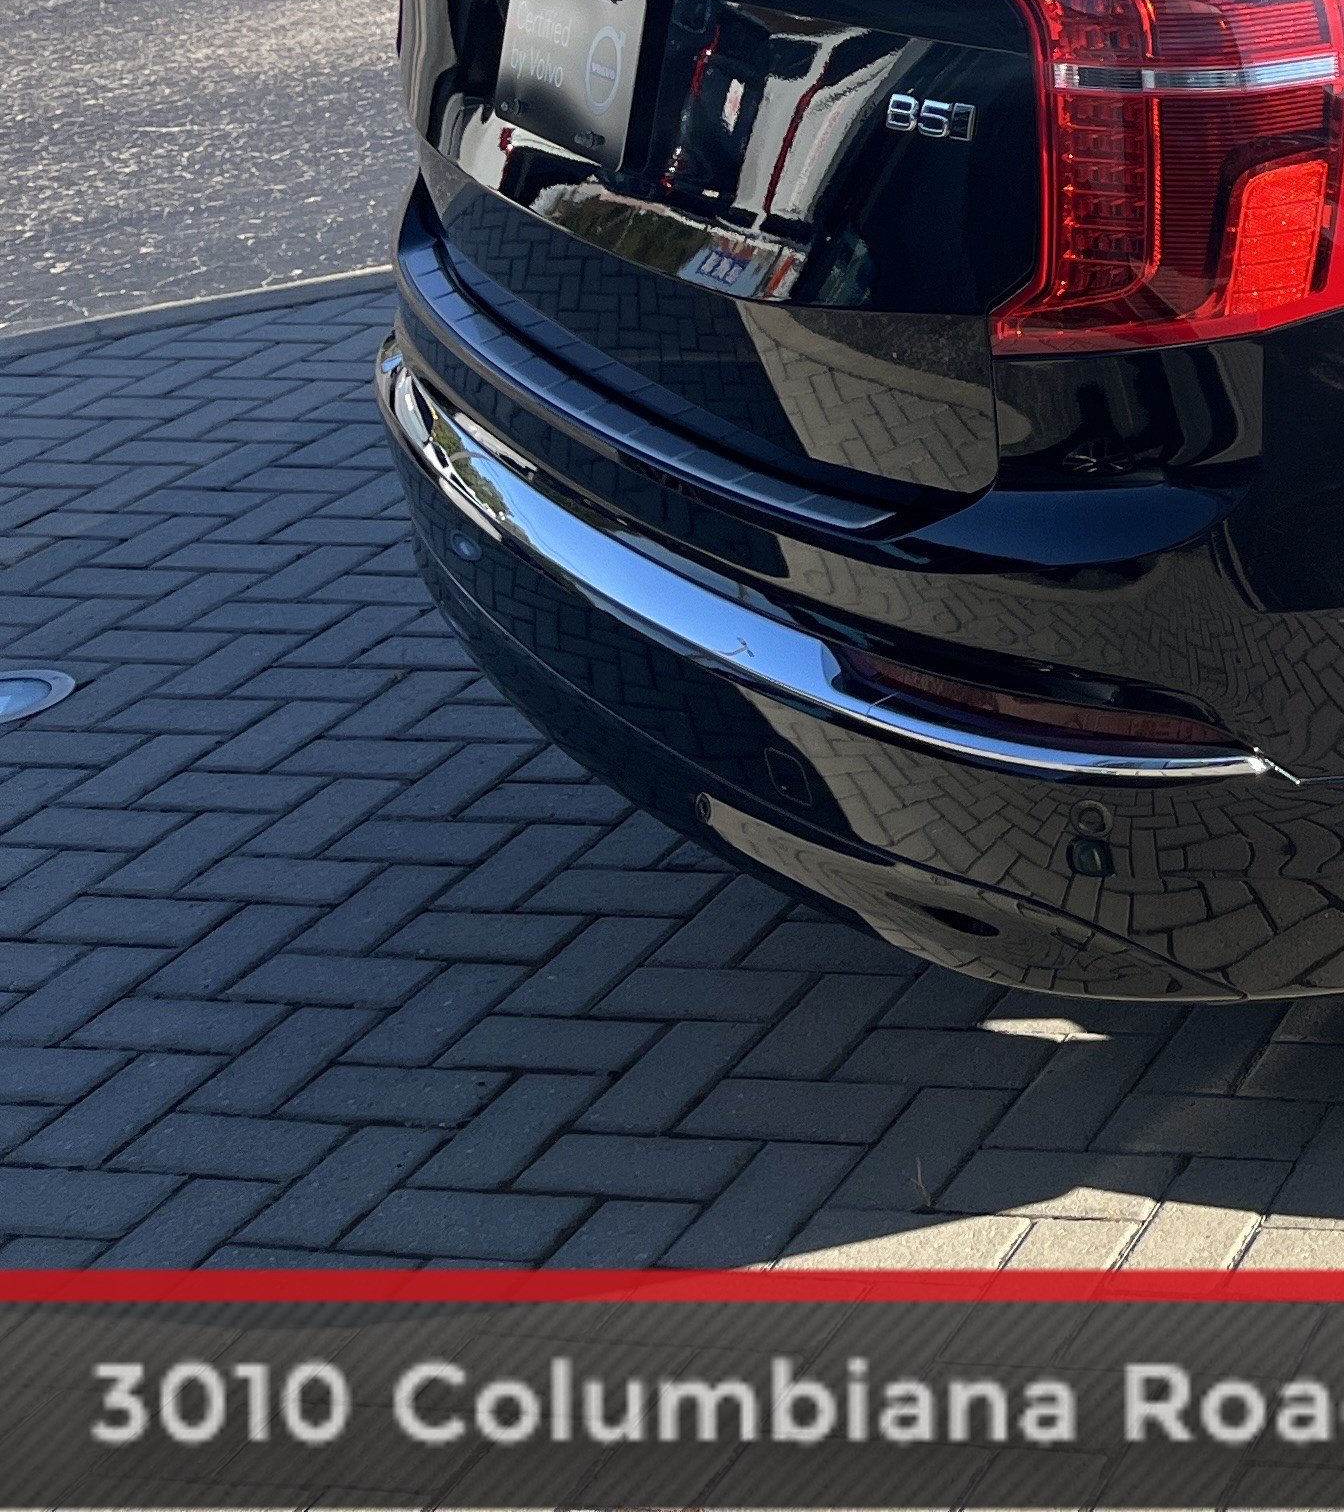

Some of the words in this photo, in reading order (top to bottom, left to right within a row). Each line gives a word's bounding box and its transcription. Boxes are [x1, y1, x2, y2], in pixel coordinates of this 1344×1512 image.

[516, 0, 573, 48] Certified
[510, 45, 526, 80] by
[529, 49, 564, 88] Volvo
[591, 62, 617, 80] VOLVO
